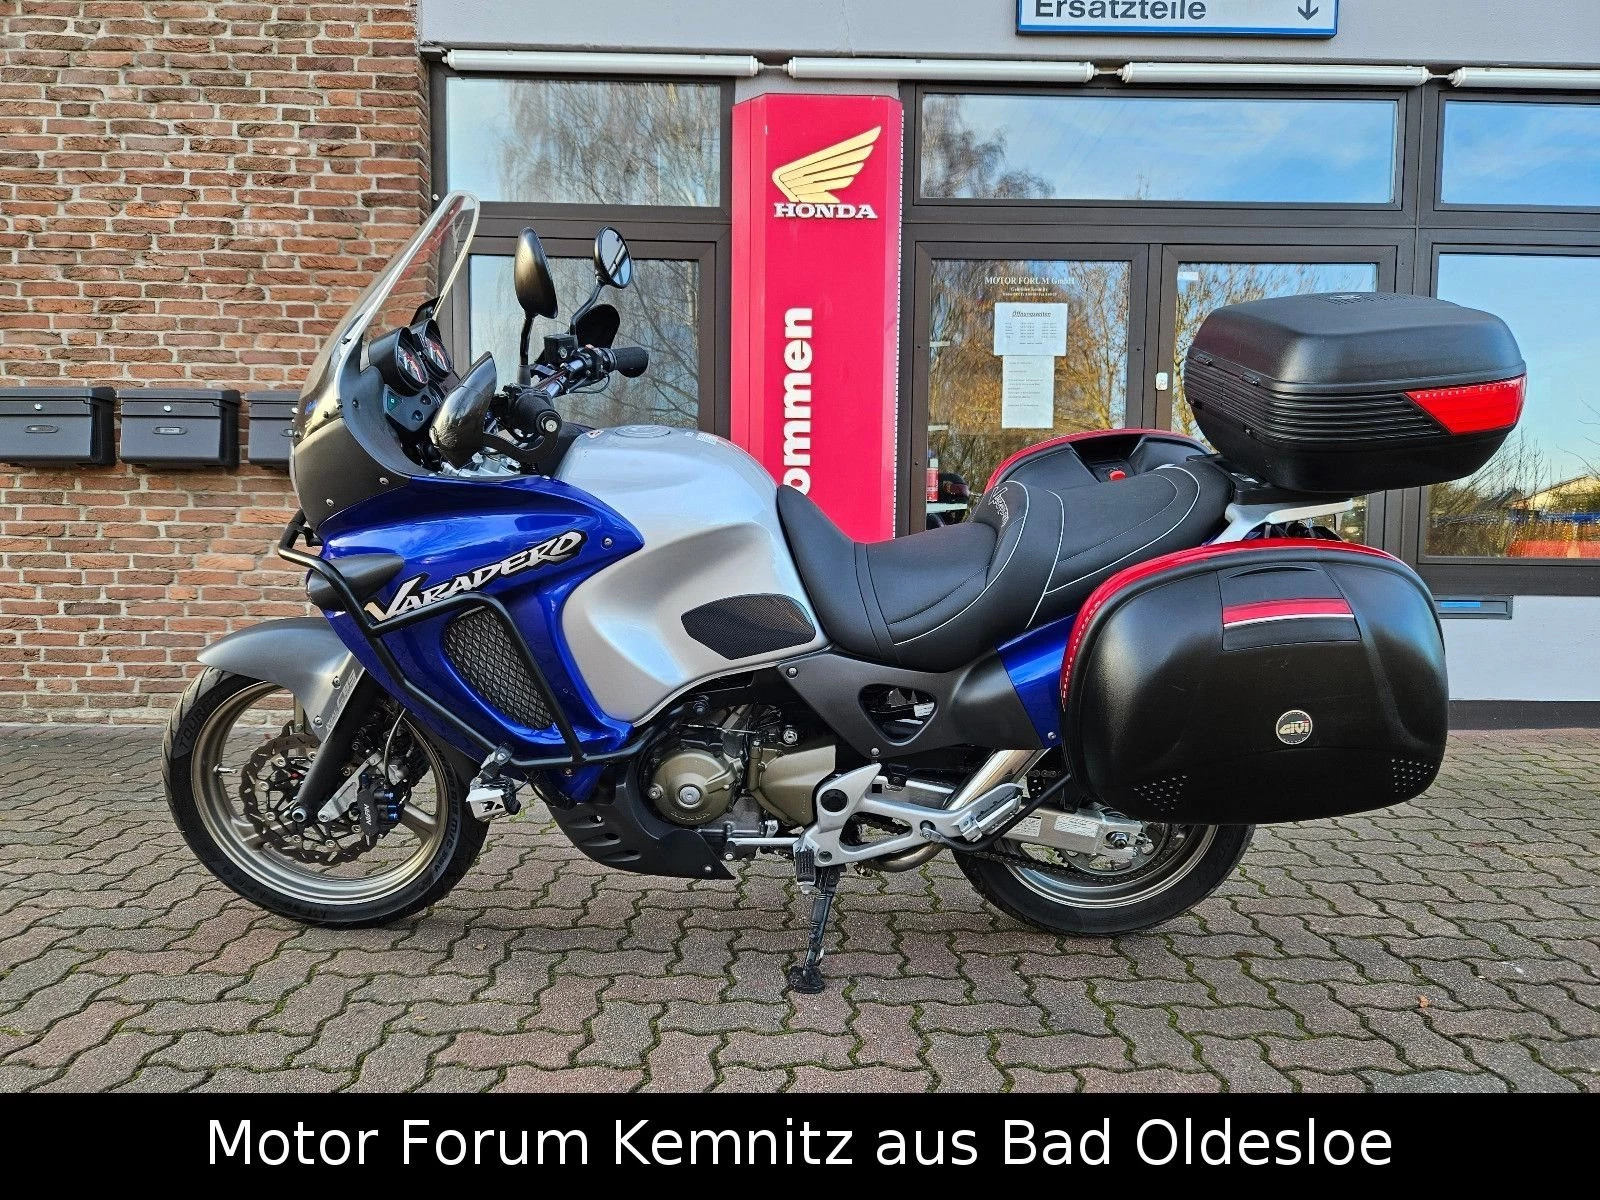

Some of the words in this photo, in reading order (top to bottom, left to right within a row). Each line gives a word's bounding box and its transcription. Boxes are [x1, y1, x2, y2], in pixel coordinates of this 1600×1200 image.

[1034, 0, 1207, 20] Ersatzteile
[773, 202, 879, 219] HONDA
[984, 276, 1017, 285] MOTOR
[1018, 276, 1050, 285] FORUM
[783, 307, 813, 496] ommen
[364, 531, 583, 622] VARADERO
